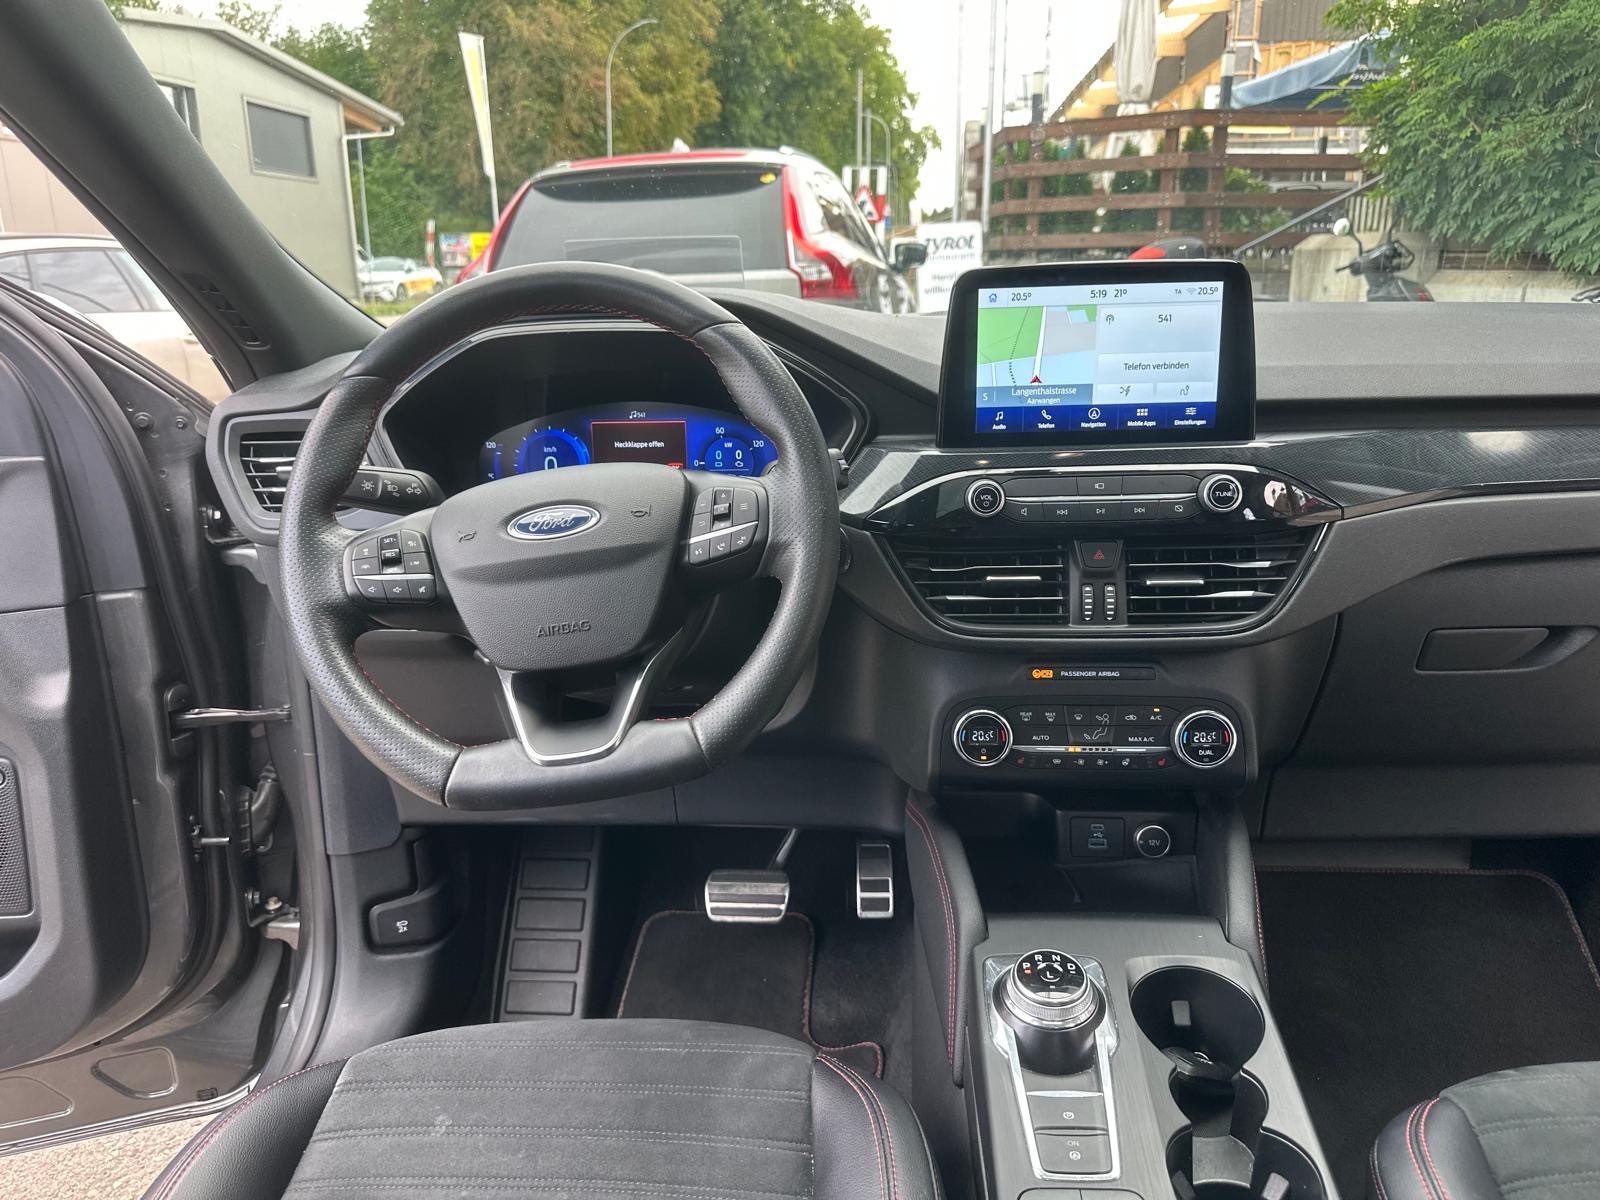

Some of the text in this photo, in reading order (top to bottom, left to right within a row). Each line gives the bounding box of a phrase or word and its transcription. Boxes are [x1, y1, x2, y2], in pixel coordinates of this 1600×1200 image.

[1090, 289, 1127, 299] 5:19 21°
[1158, 314, 1172, 323] 541
[1124, 361, 1189, 370] Telefon verbinden
[1011, 387, 1077, 397] Langenthalstrasse
[614, 441, 648, 449] Heckklappe
[753, 440, 764, 448] 120
[716, 450, 722, 460] 0
[735, 449, 742, 460] 0
[694, 459, 699, 467] 0
[1215, 490, 1233, 498] TUNE
[529, 512, 576, 532] Ford
[537, 620, 592, 638] AIRBAG
